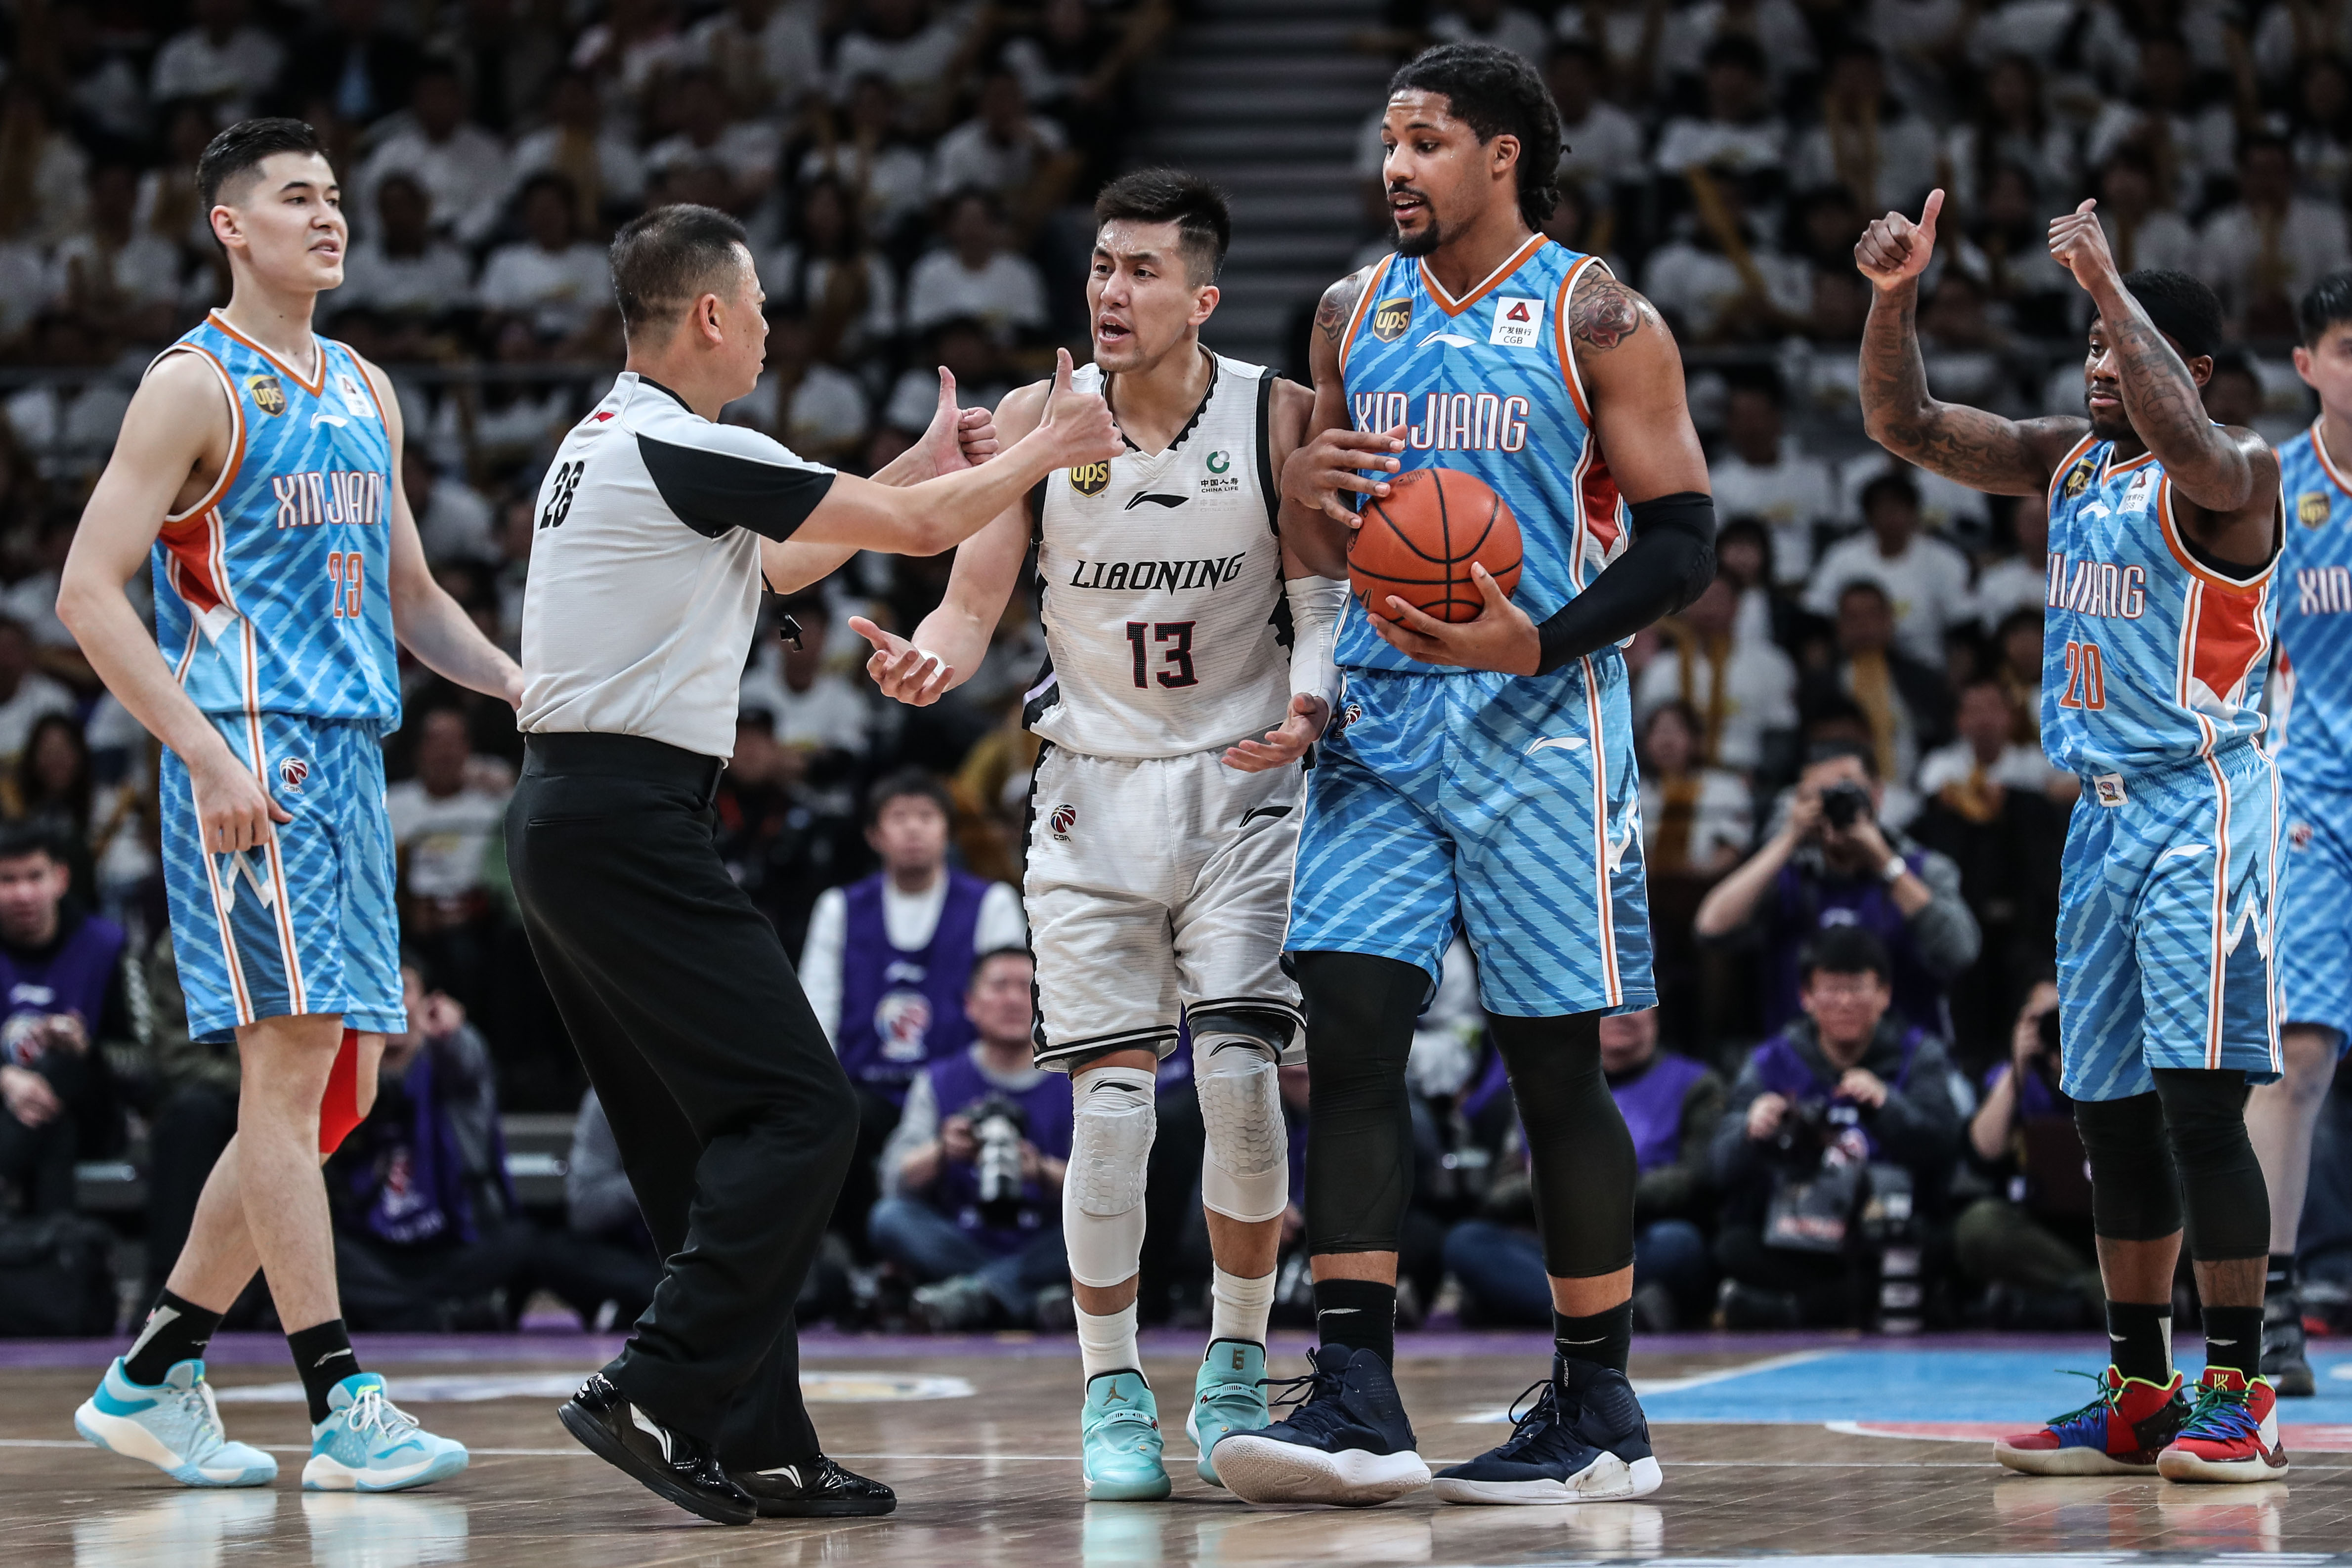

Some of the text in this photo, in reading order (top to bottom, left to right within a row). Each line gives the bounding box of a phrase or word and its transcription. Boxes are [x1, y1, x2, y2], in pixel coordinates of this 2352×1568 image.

[1376, 311, 1409, 336] ups
[1499, 326, 1532, 336] 广发银行
[1503, 336, 1523, 344] CGB
[253, 387, 282, 411] ups
[1072, 463, 1108, 490] ups
[1200, 477, 1239, 487] 中国人寿
[539, 460, 585, 530] 28
[327, 551, 364, 619] 23
[1069, 551, 1246, 597] LIAONING
[1126, 620, 1199, 689] 13
[2058, 640, 2106, 712] 20
[1053, 834, 1071, 842] CBA
